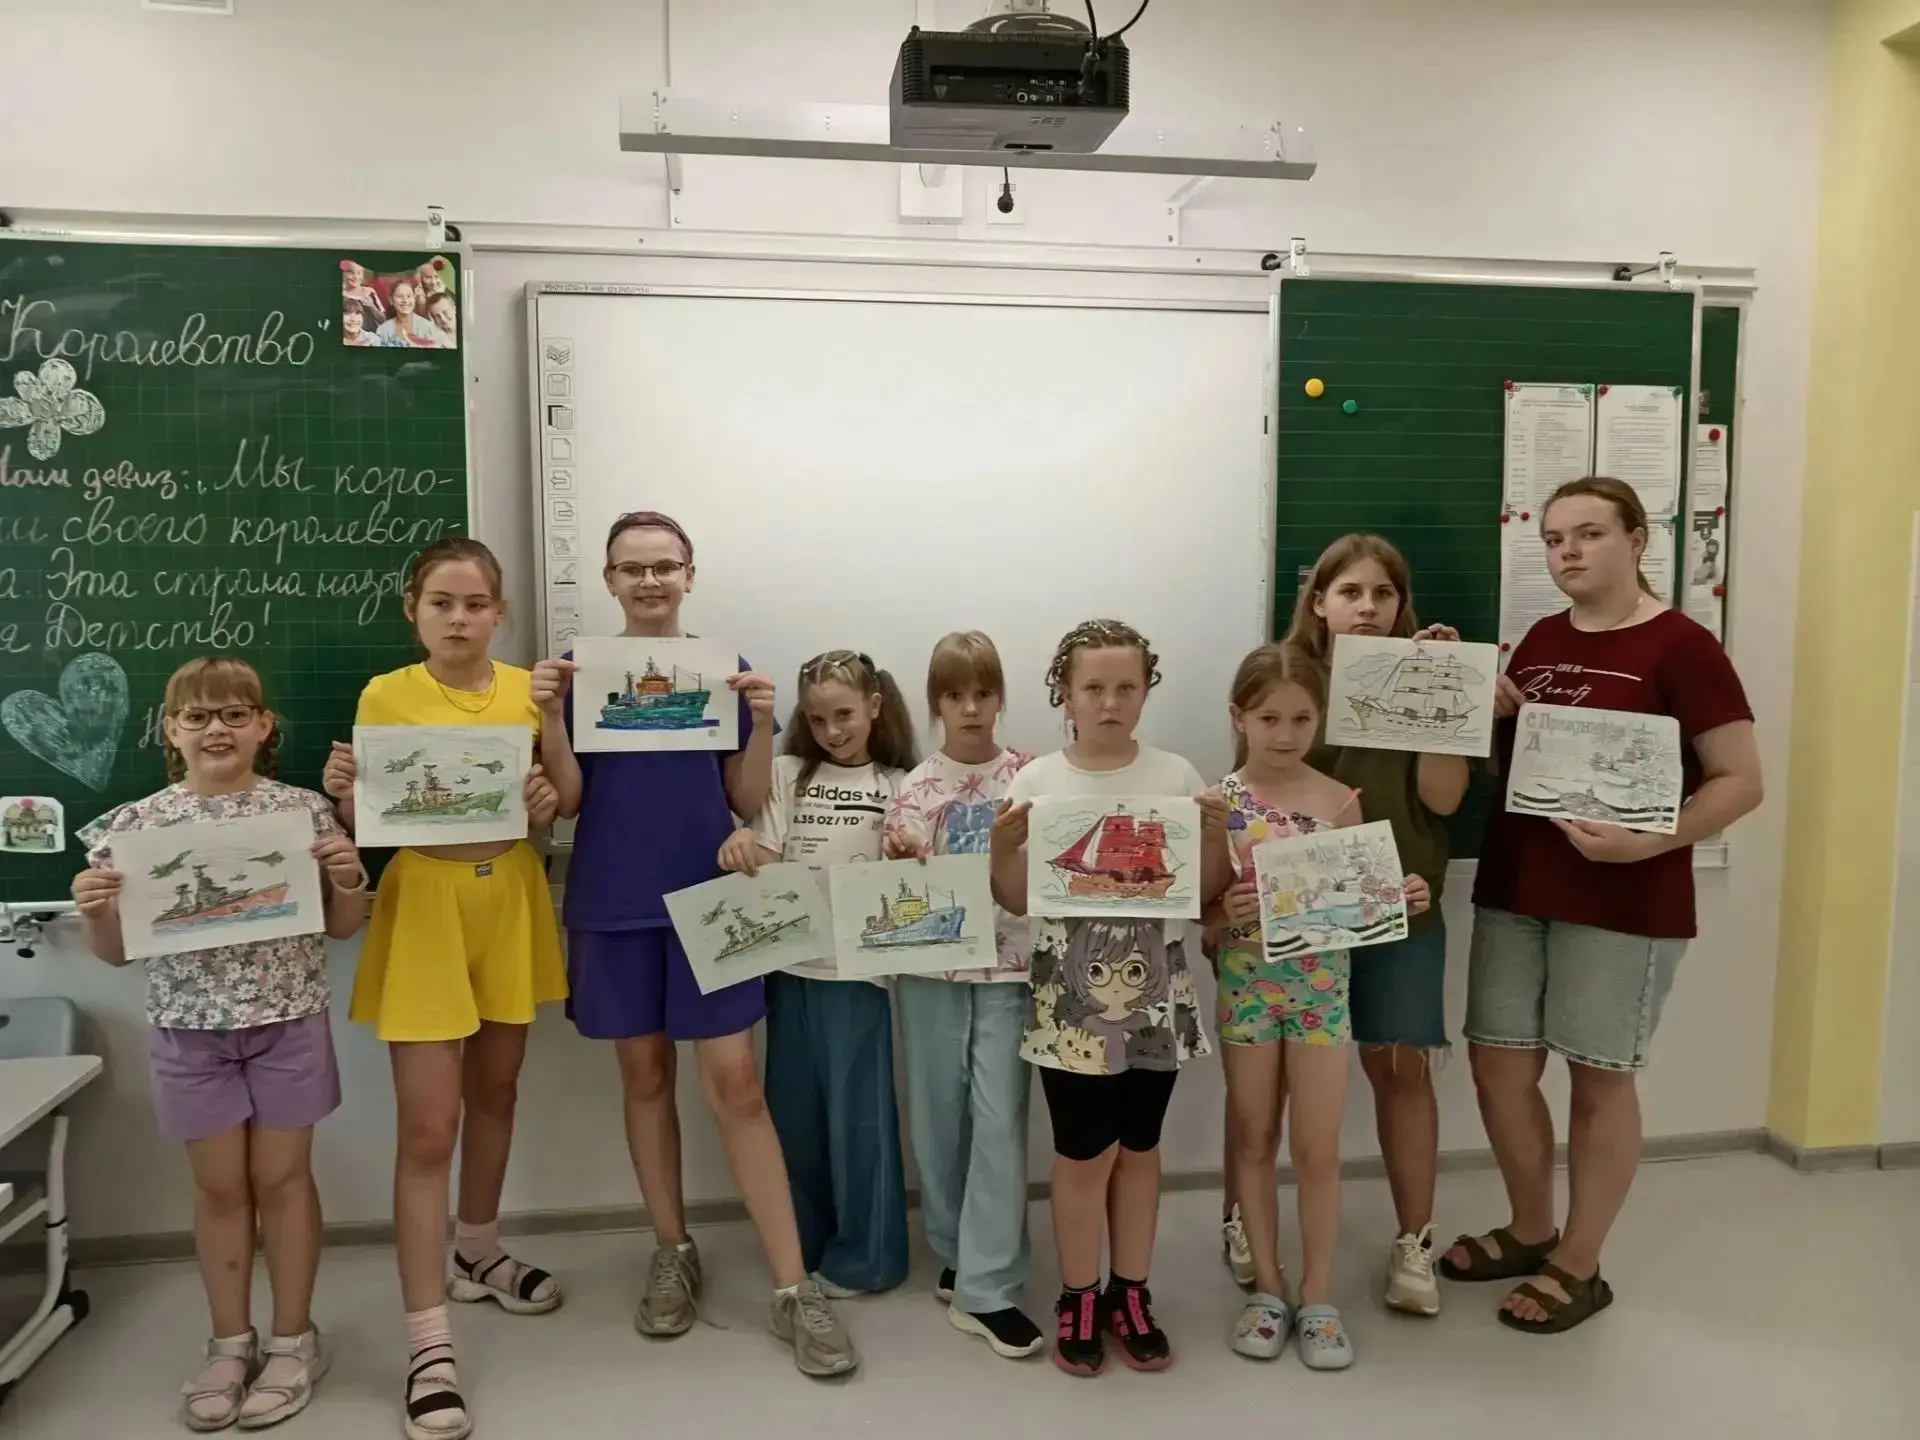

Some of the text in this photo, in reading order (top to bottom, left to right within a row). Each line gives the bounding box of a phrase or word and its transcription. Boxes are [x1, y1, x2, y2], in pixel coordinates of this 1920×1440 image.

[62, 496, 207, 545] своего
[46, 546, 139, 601] Эта
[153, 566, 306, 616] страна
[45, 602, 271, 652] Детство!
[817, 815, 834, 825] OZ
